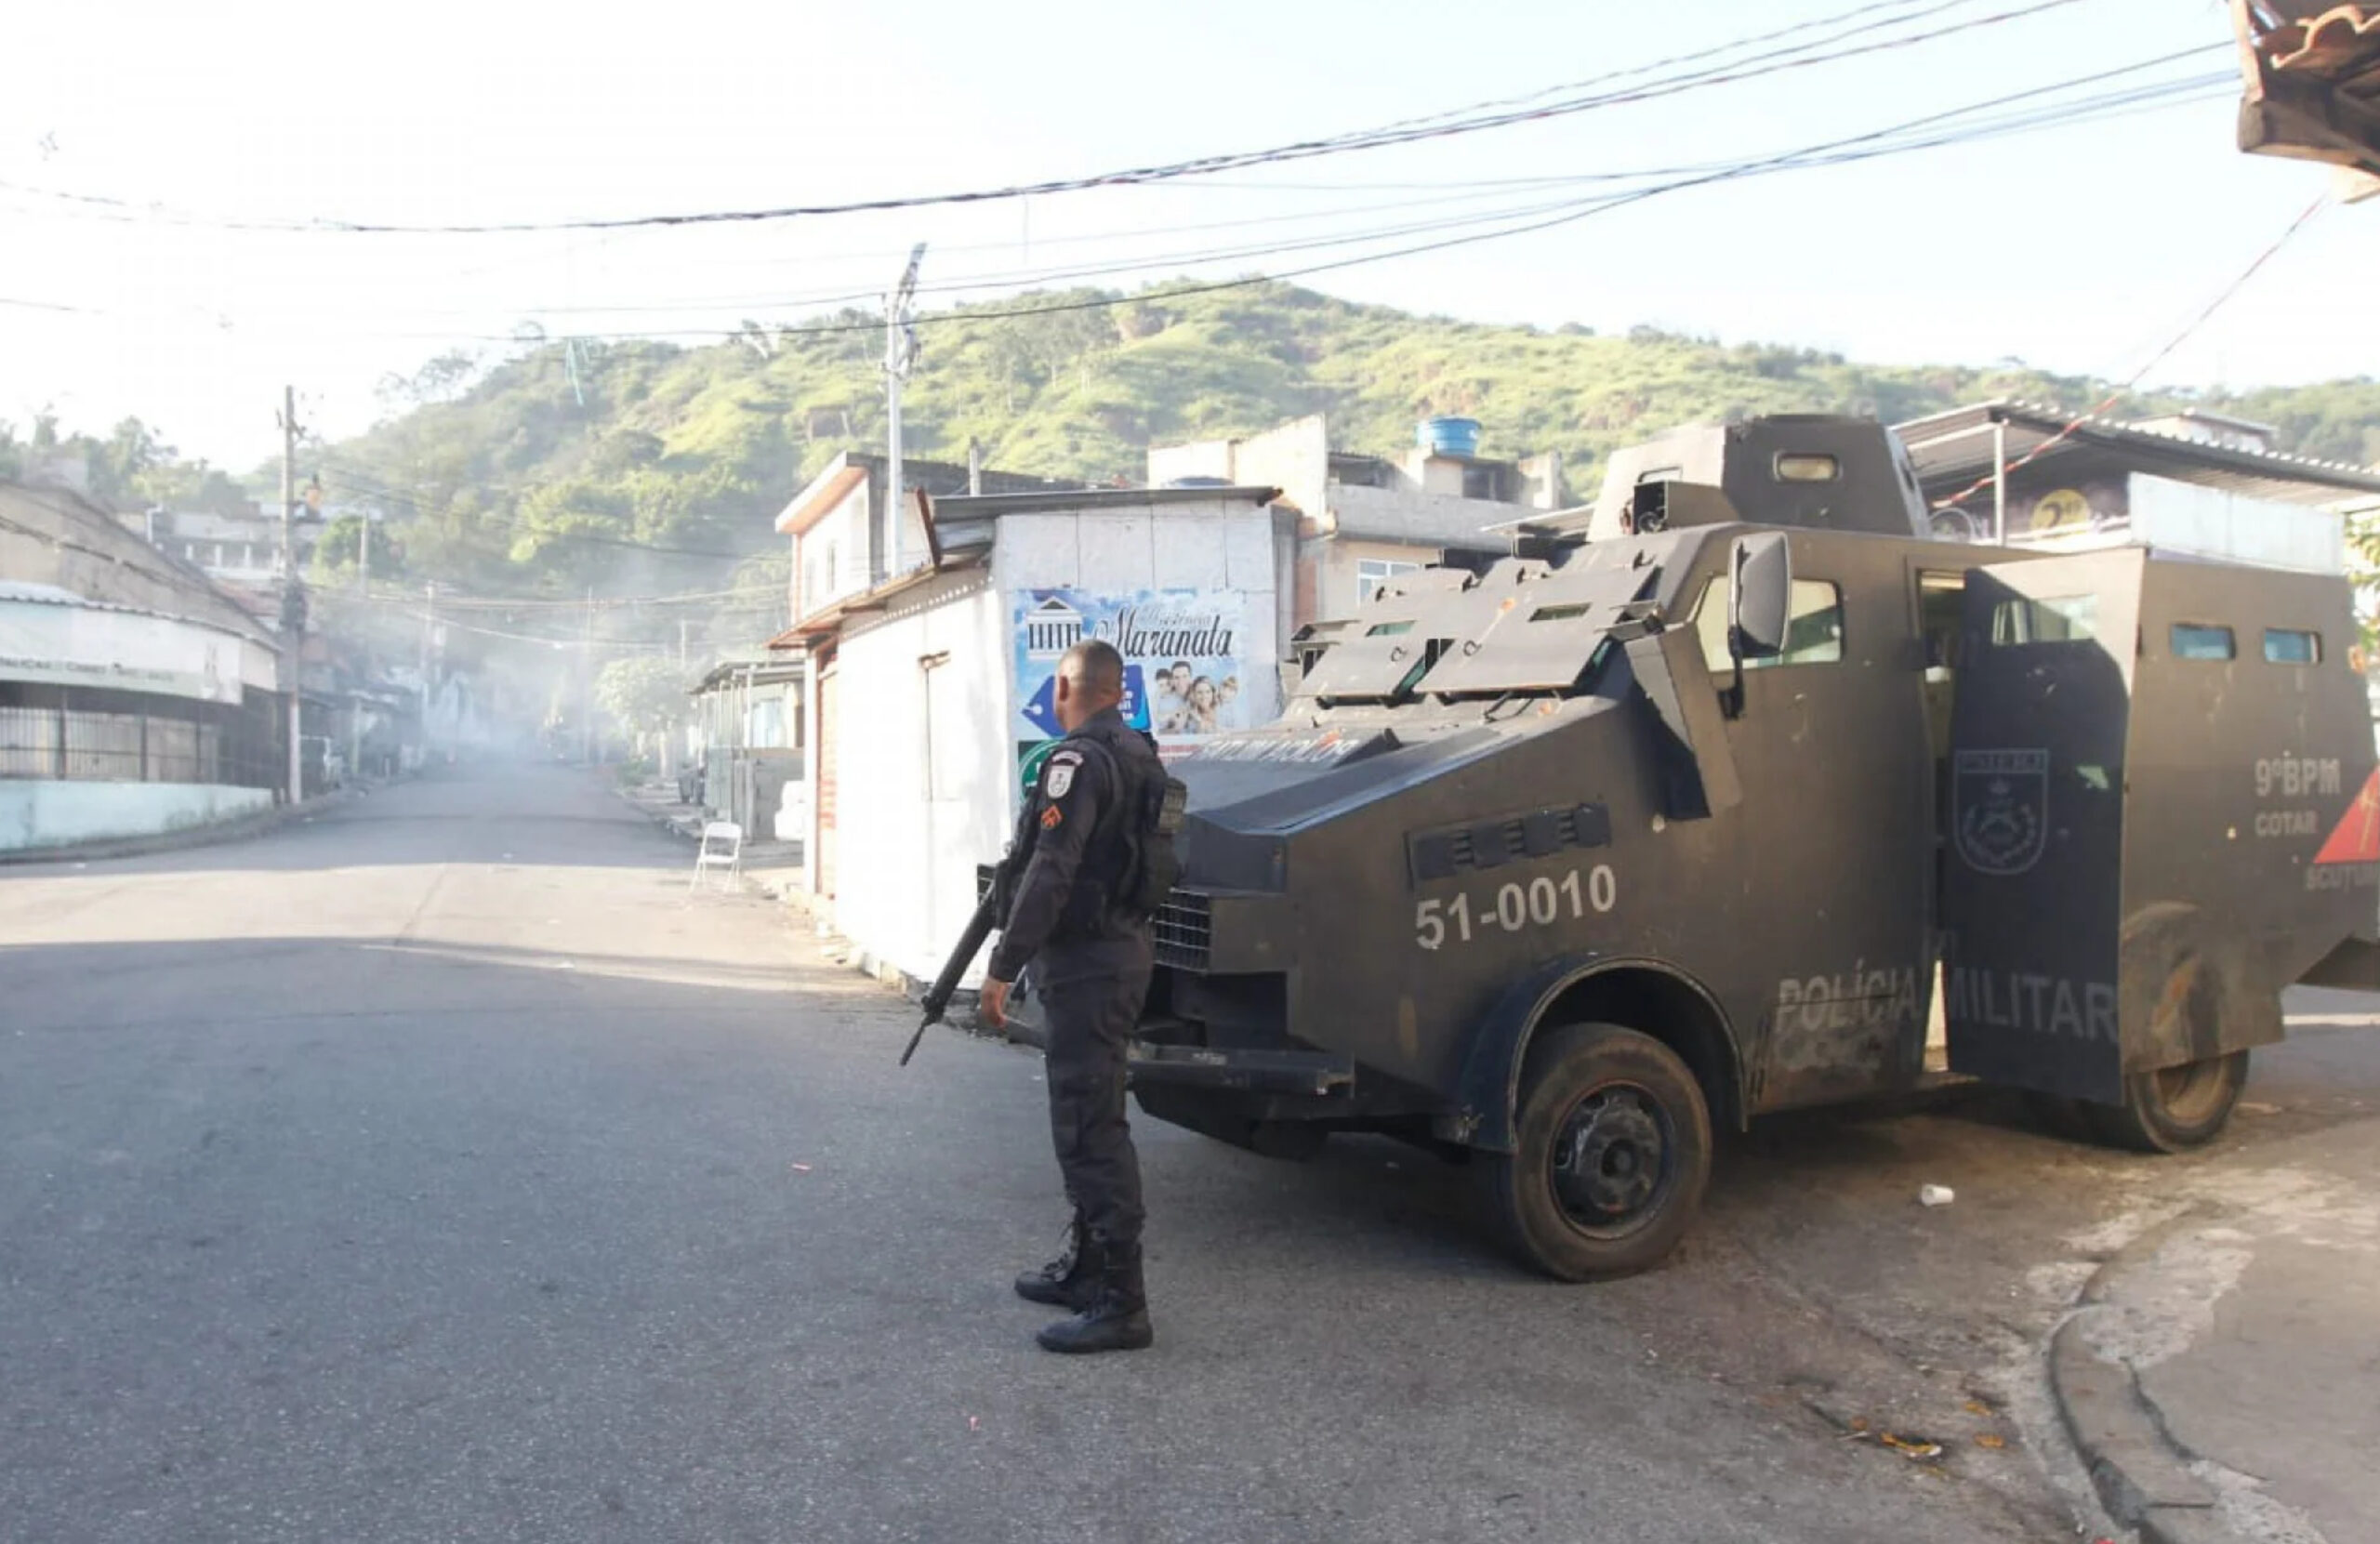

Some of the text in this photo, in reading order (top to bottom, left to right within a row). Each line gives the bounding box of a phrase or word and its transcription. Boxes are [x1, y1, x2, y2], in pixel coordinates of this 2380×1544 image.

[1093, 604, 1233, 658] Maranata
[2254, 811, 2319, 837] COTAR
[1416, 864, 1616, 950] 51-0010
[1776, 957, 1919, 1032] POLÍCIA
